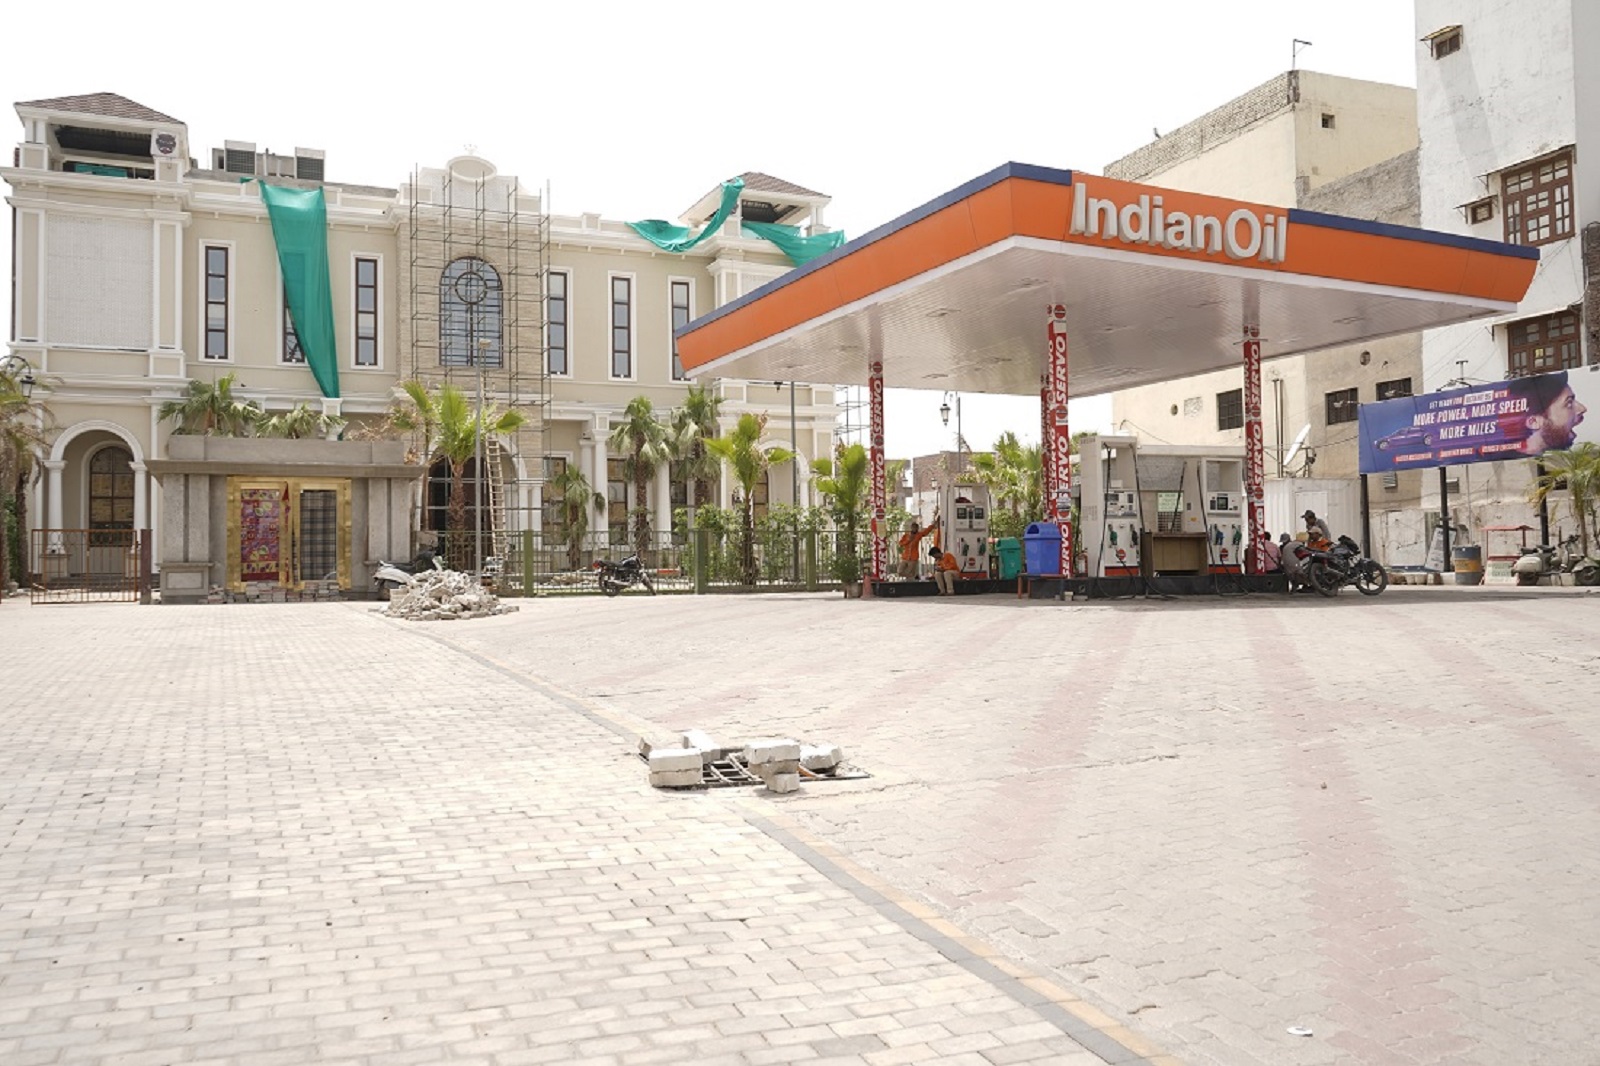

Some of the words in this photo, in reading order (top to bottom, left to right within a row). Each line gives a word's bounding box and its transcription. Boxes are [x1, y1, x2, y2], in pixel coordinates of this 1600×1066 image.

[1070, 182, 1288, 264] IndianOil
[1055, 335, 1067, 405] SERVO
[1251, 344, 1261, 406] SERVO
[873, 379, 882, 434] SERVO
[1413, 413, 1435, 426] MORE
[1436, 408, 1469, 423] POWER,
[1471, 403, 1496, 418] MORE
[1498, 398, 1530, 415] SPEED,
[1439, 426, 1467, 440] MORE
[875, 453, 884, 508] SERVO
[1253, 424, 1264, 487] SERVO
[878, 536, 888, 581] SERV
[1061, 524, 1070, 579] SERVO
[1256, 507, 1265, 572] SERVO
